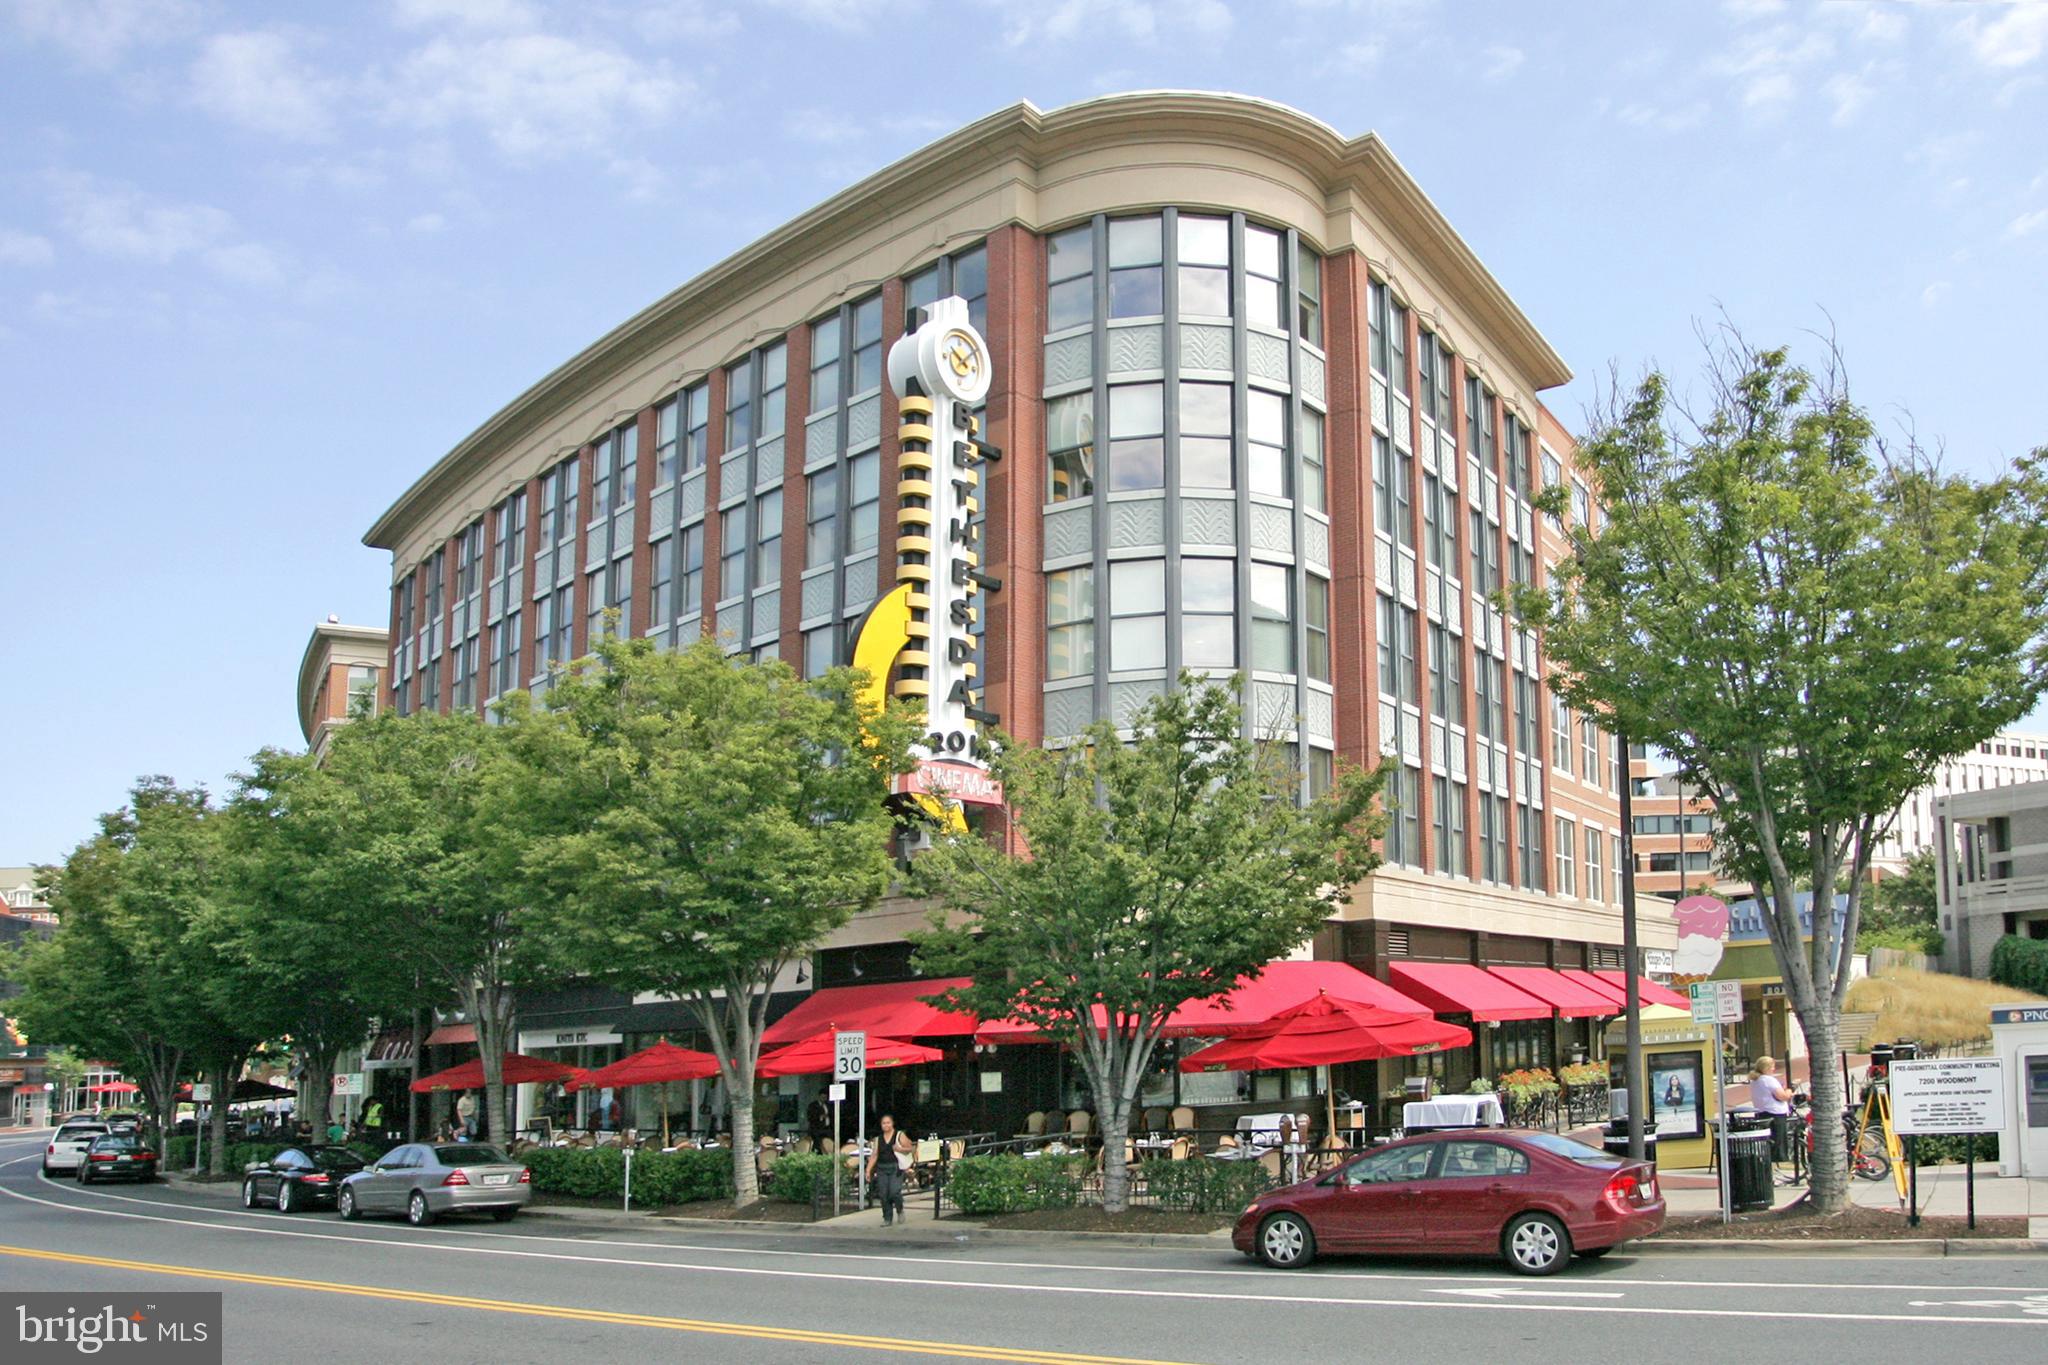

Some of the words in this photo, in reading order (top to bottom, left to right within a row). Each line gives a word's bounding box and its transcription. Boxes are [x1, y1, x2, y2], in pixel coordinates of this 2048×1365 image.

[947, 401, 972, 707] BETHESDA
[916, 764, 995, 798] CINEMA
[1721, 983, 1734, 991] NO
[838, 1037, 863, 1045] SPEED
[1645, 1032, 1705, 1043] CINEMA
[841, 1047, 859, 1055] LIMIT
[839, 1057, 862, 1074] 30
[1937, 1076, 1977, 1084] WOODMONT
